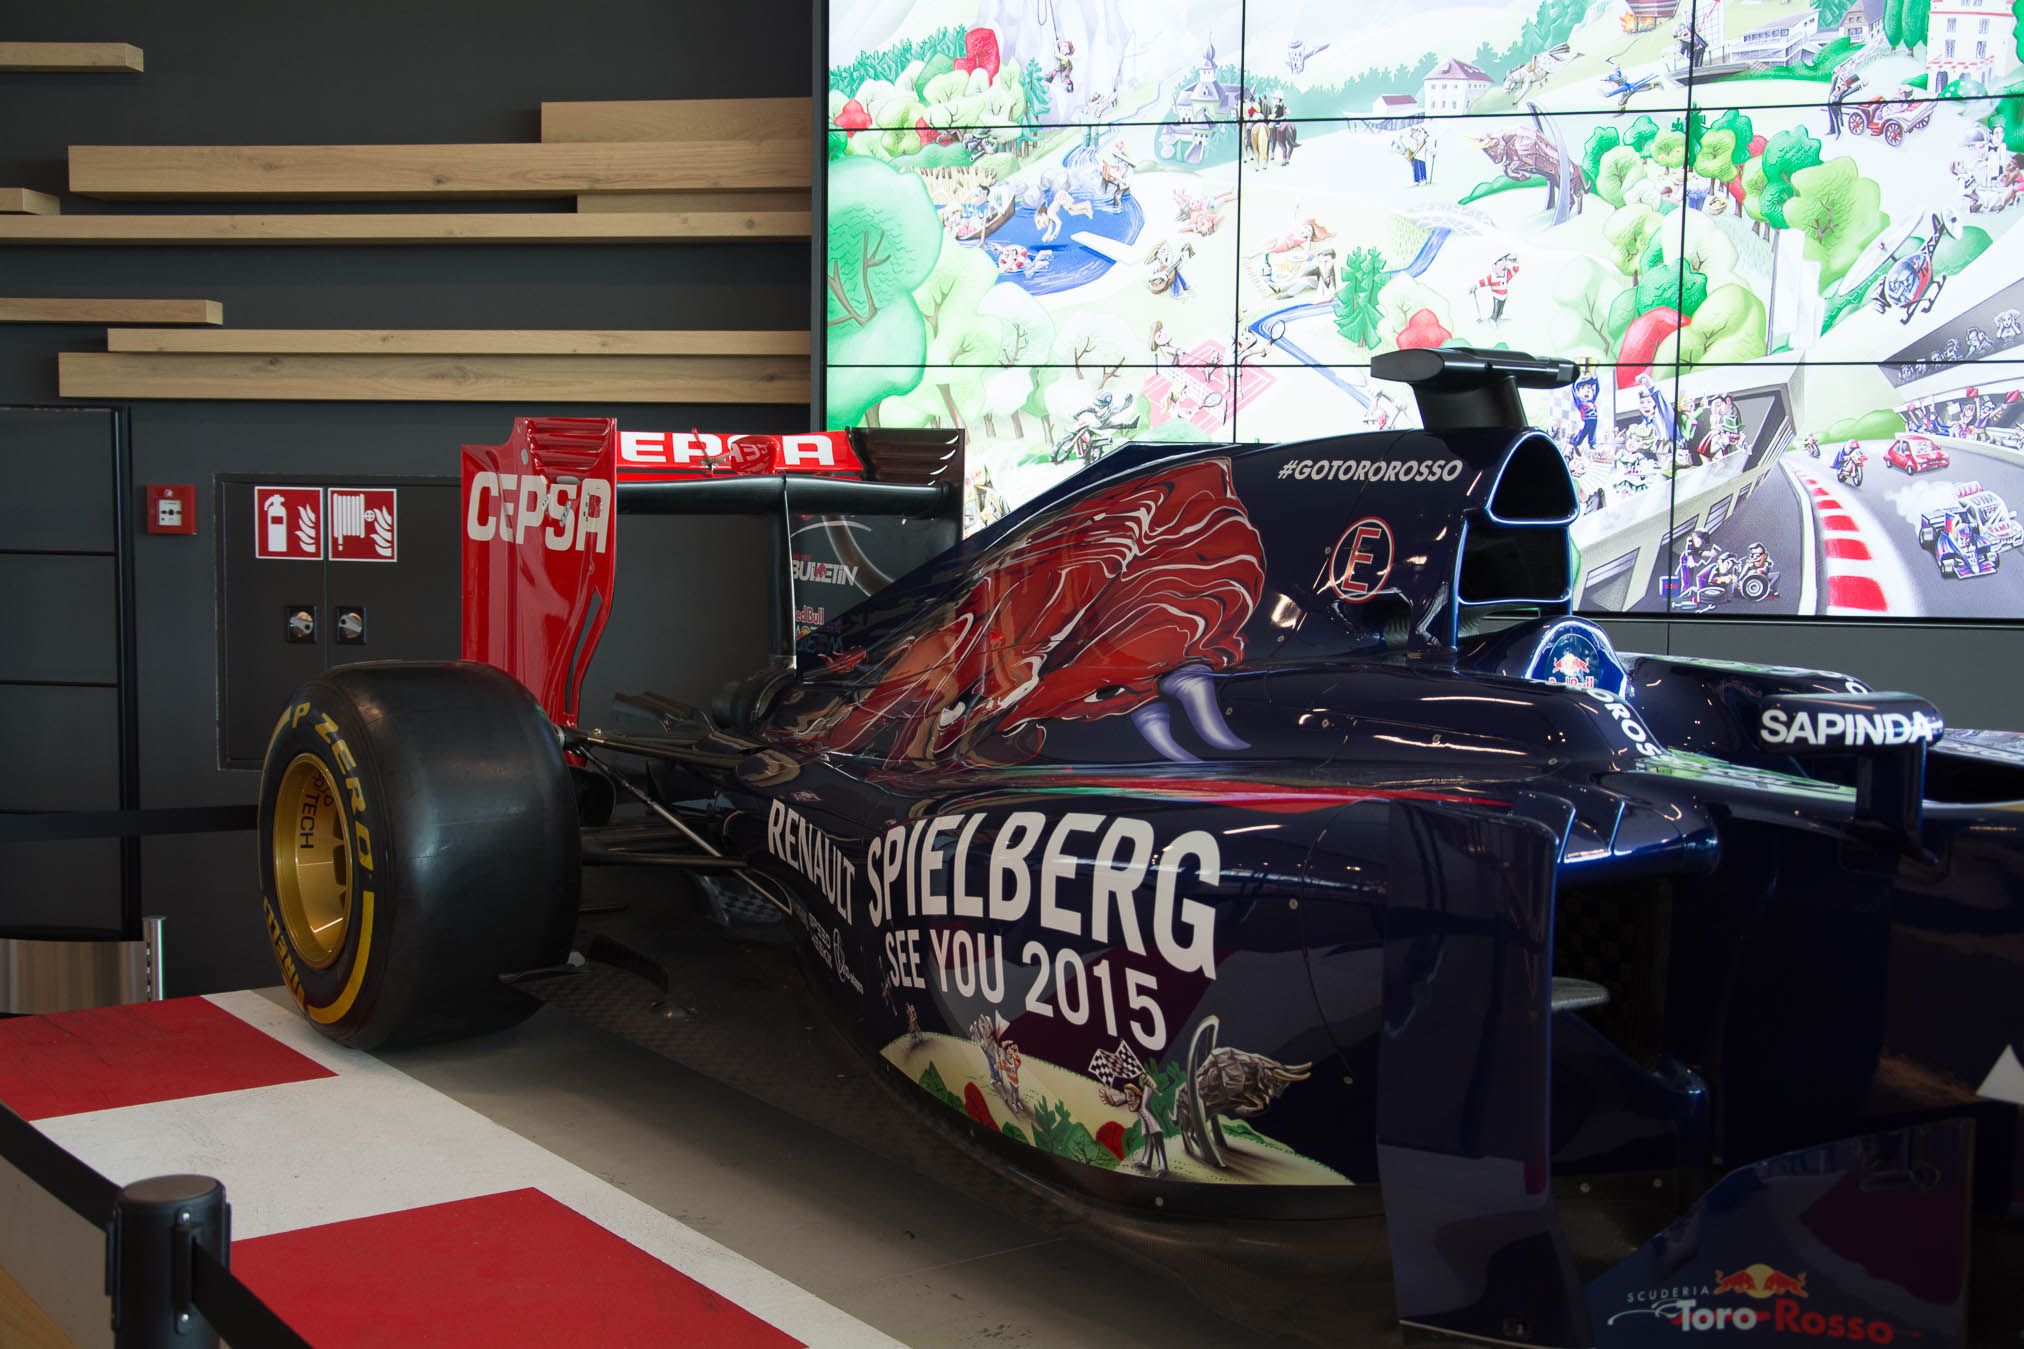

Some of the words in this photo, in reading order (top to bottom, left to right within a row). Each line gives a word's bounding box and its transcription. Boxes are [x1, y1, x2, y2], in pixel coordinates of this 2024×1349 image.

[1276, 458, 1464, 482] #GOTOROROSSO
[467, 470, 612, 554] CEPSA
[807, 607, 825, 625] Bull
[1760, 708, 1934, 747] SAPINDA
[291, 701, 312, 729] P
[313, 711, 376, 872] ZERO
[299, 793, 321, 850] TECH
[766, 797, 856, 928] RENAULT
[866, 810, 1221, 981] SPIELBERG
[884, 929, 926, 990] SEE
[929, 929, 1005, 1005] YOU
[1022, 940, 1168, 1052] 2015
[1625, 1284, 1711, 1304] SCUDERIA
[1668, 1298, 1760, 1333] Toro
[1773, 1297, 1897, 1346] Rosso
